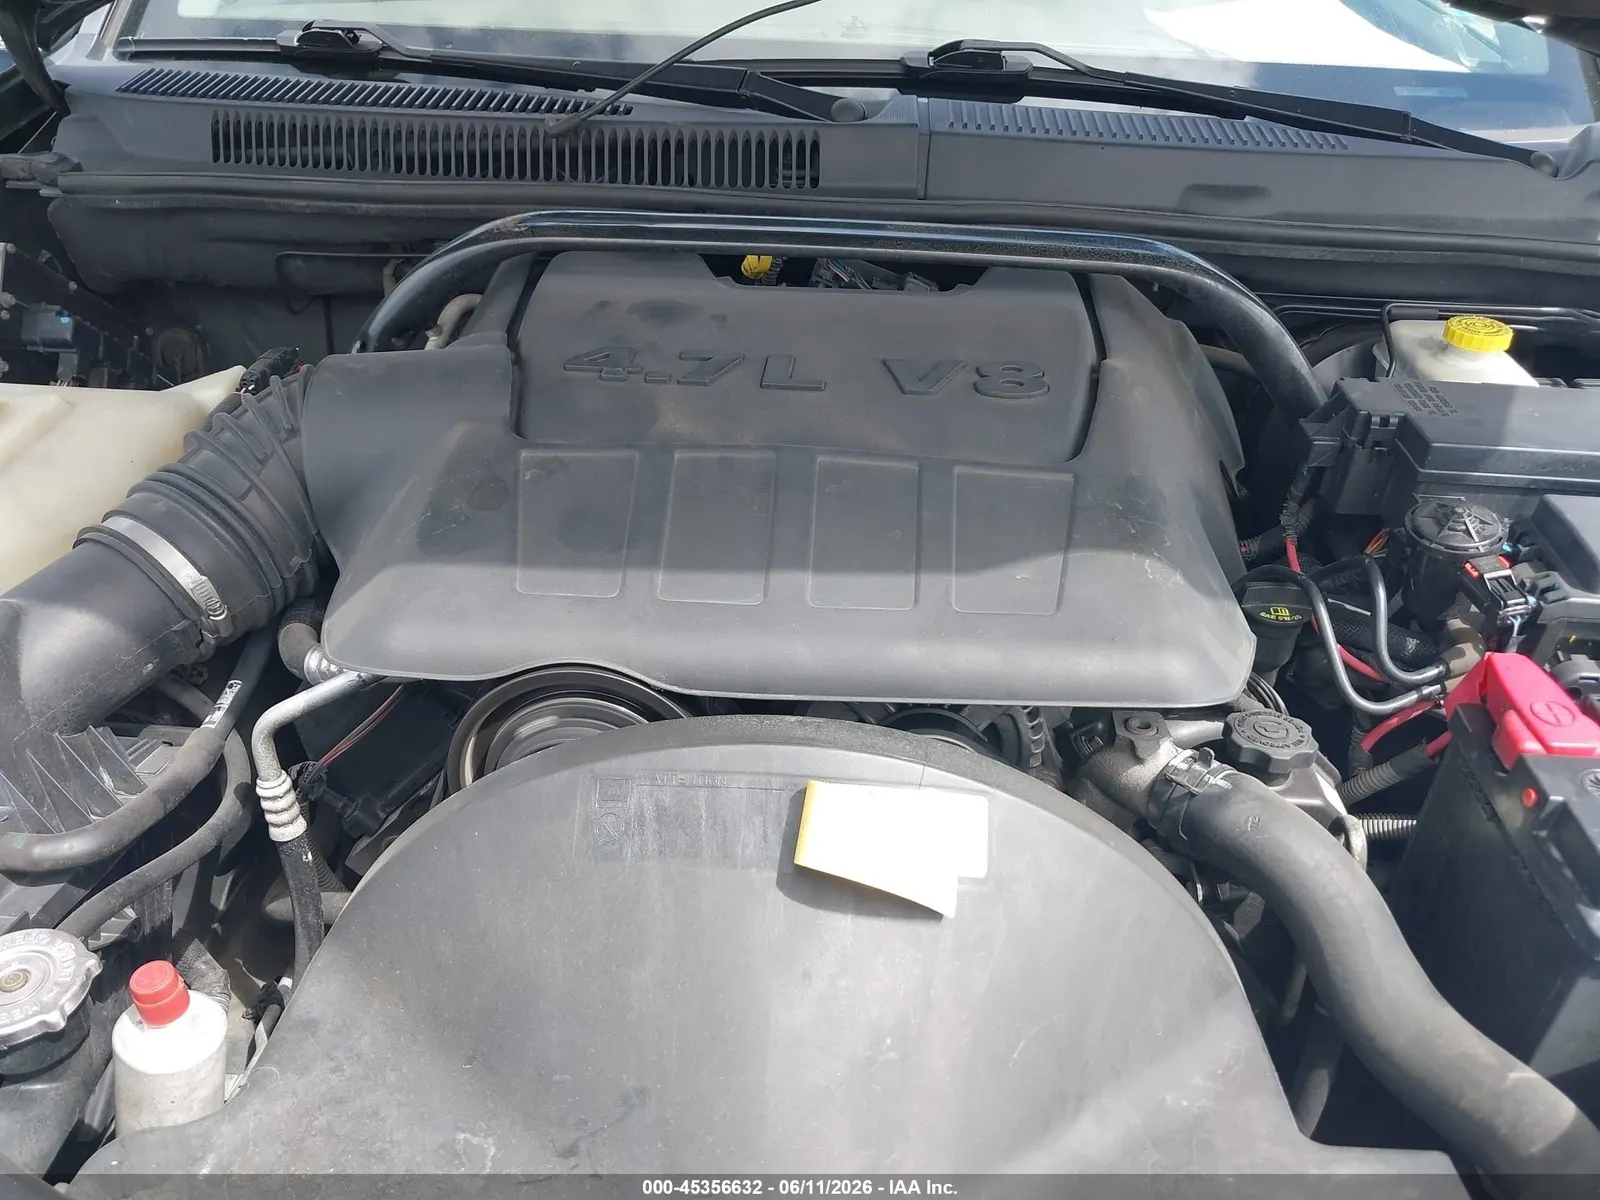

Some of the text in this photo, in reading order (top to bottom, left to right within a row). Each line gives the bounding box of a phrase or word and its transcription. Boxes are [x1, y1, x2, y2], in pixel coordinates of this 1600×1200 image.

[563, 346, 1051, 399] 4.7L V8
[1260, 611, 1277, 620] SAE
